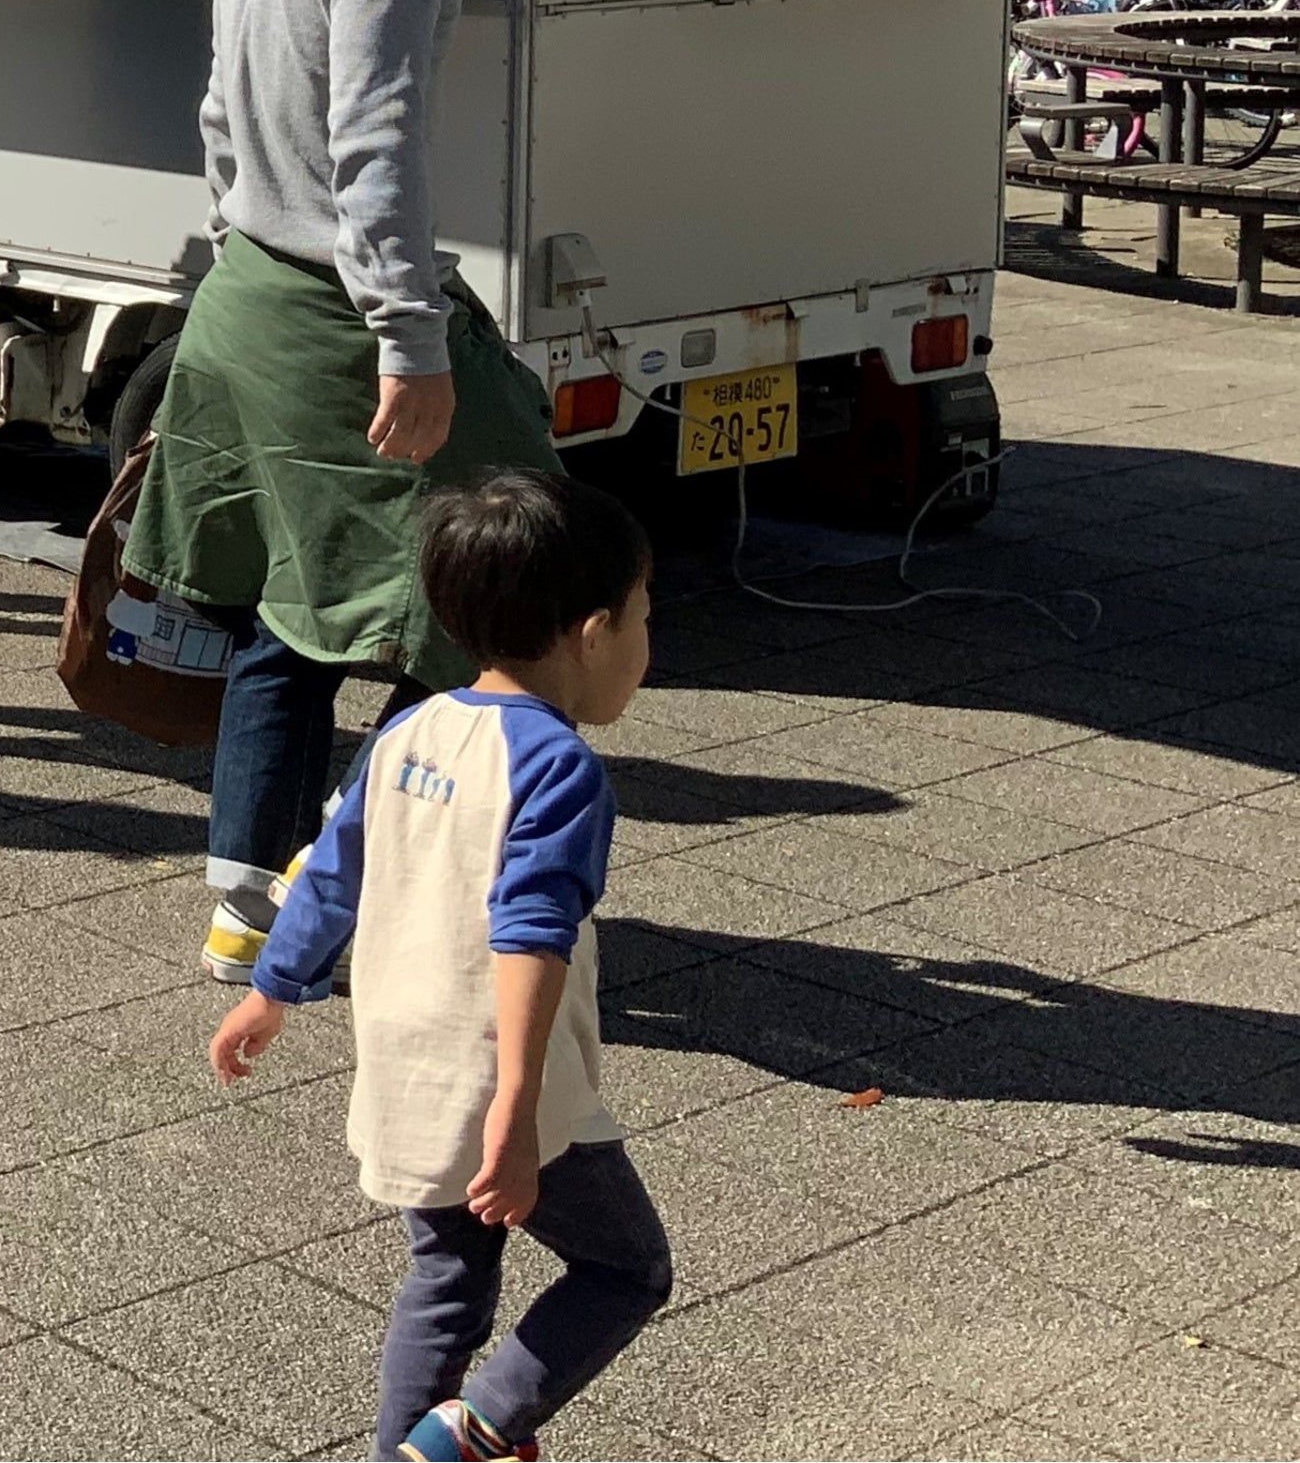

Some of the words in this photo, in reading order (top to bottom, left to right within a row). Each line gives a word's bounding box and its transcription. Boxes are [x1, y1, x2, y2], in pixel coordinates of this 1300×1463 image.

[713, 382, 742, 406] 相模
[745, 376, 772, 401] 480
[690, 431, 705, 451] た
[708, 403, 790, 462] 20-57
